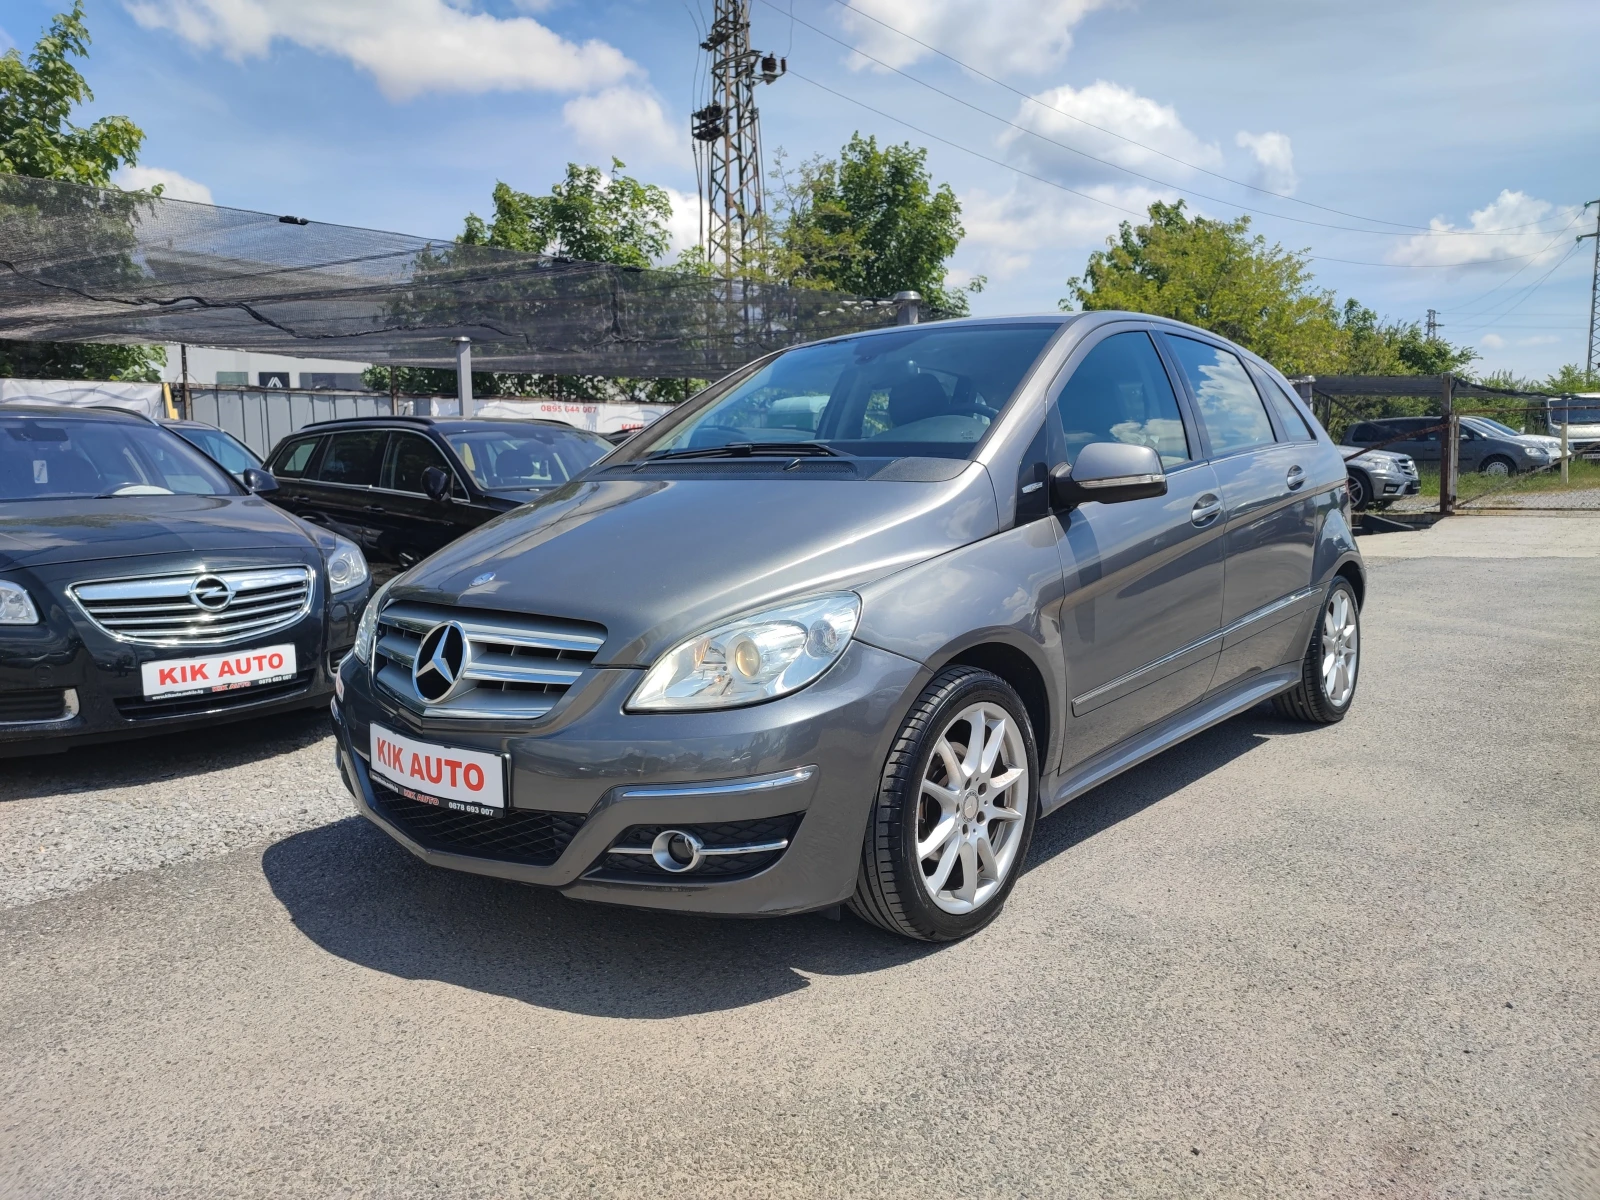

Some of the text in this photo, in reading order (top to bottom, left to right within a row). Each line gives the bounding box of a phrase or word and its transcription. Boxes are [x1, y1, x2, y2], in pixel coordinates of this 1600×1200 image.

[541, 405, 562, 413] 0895
[158, 653, 284, 685] KIK AUTO
[377, 736, 404, 774] KIK
[410, 752, 485, 792] AUTO
[417, 794, 439, 805] AUTO
[448, 801, 494, 816] 0878 693 007
